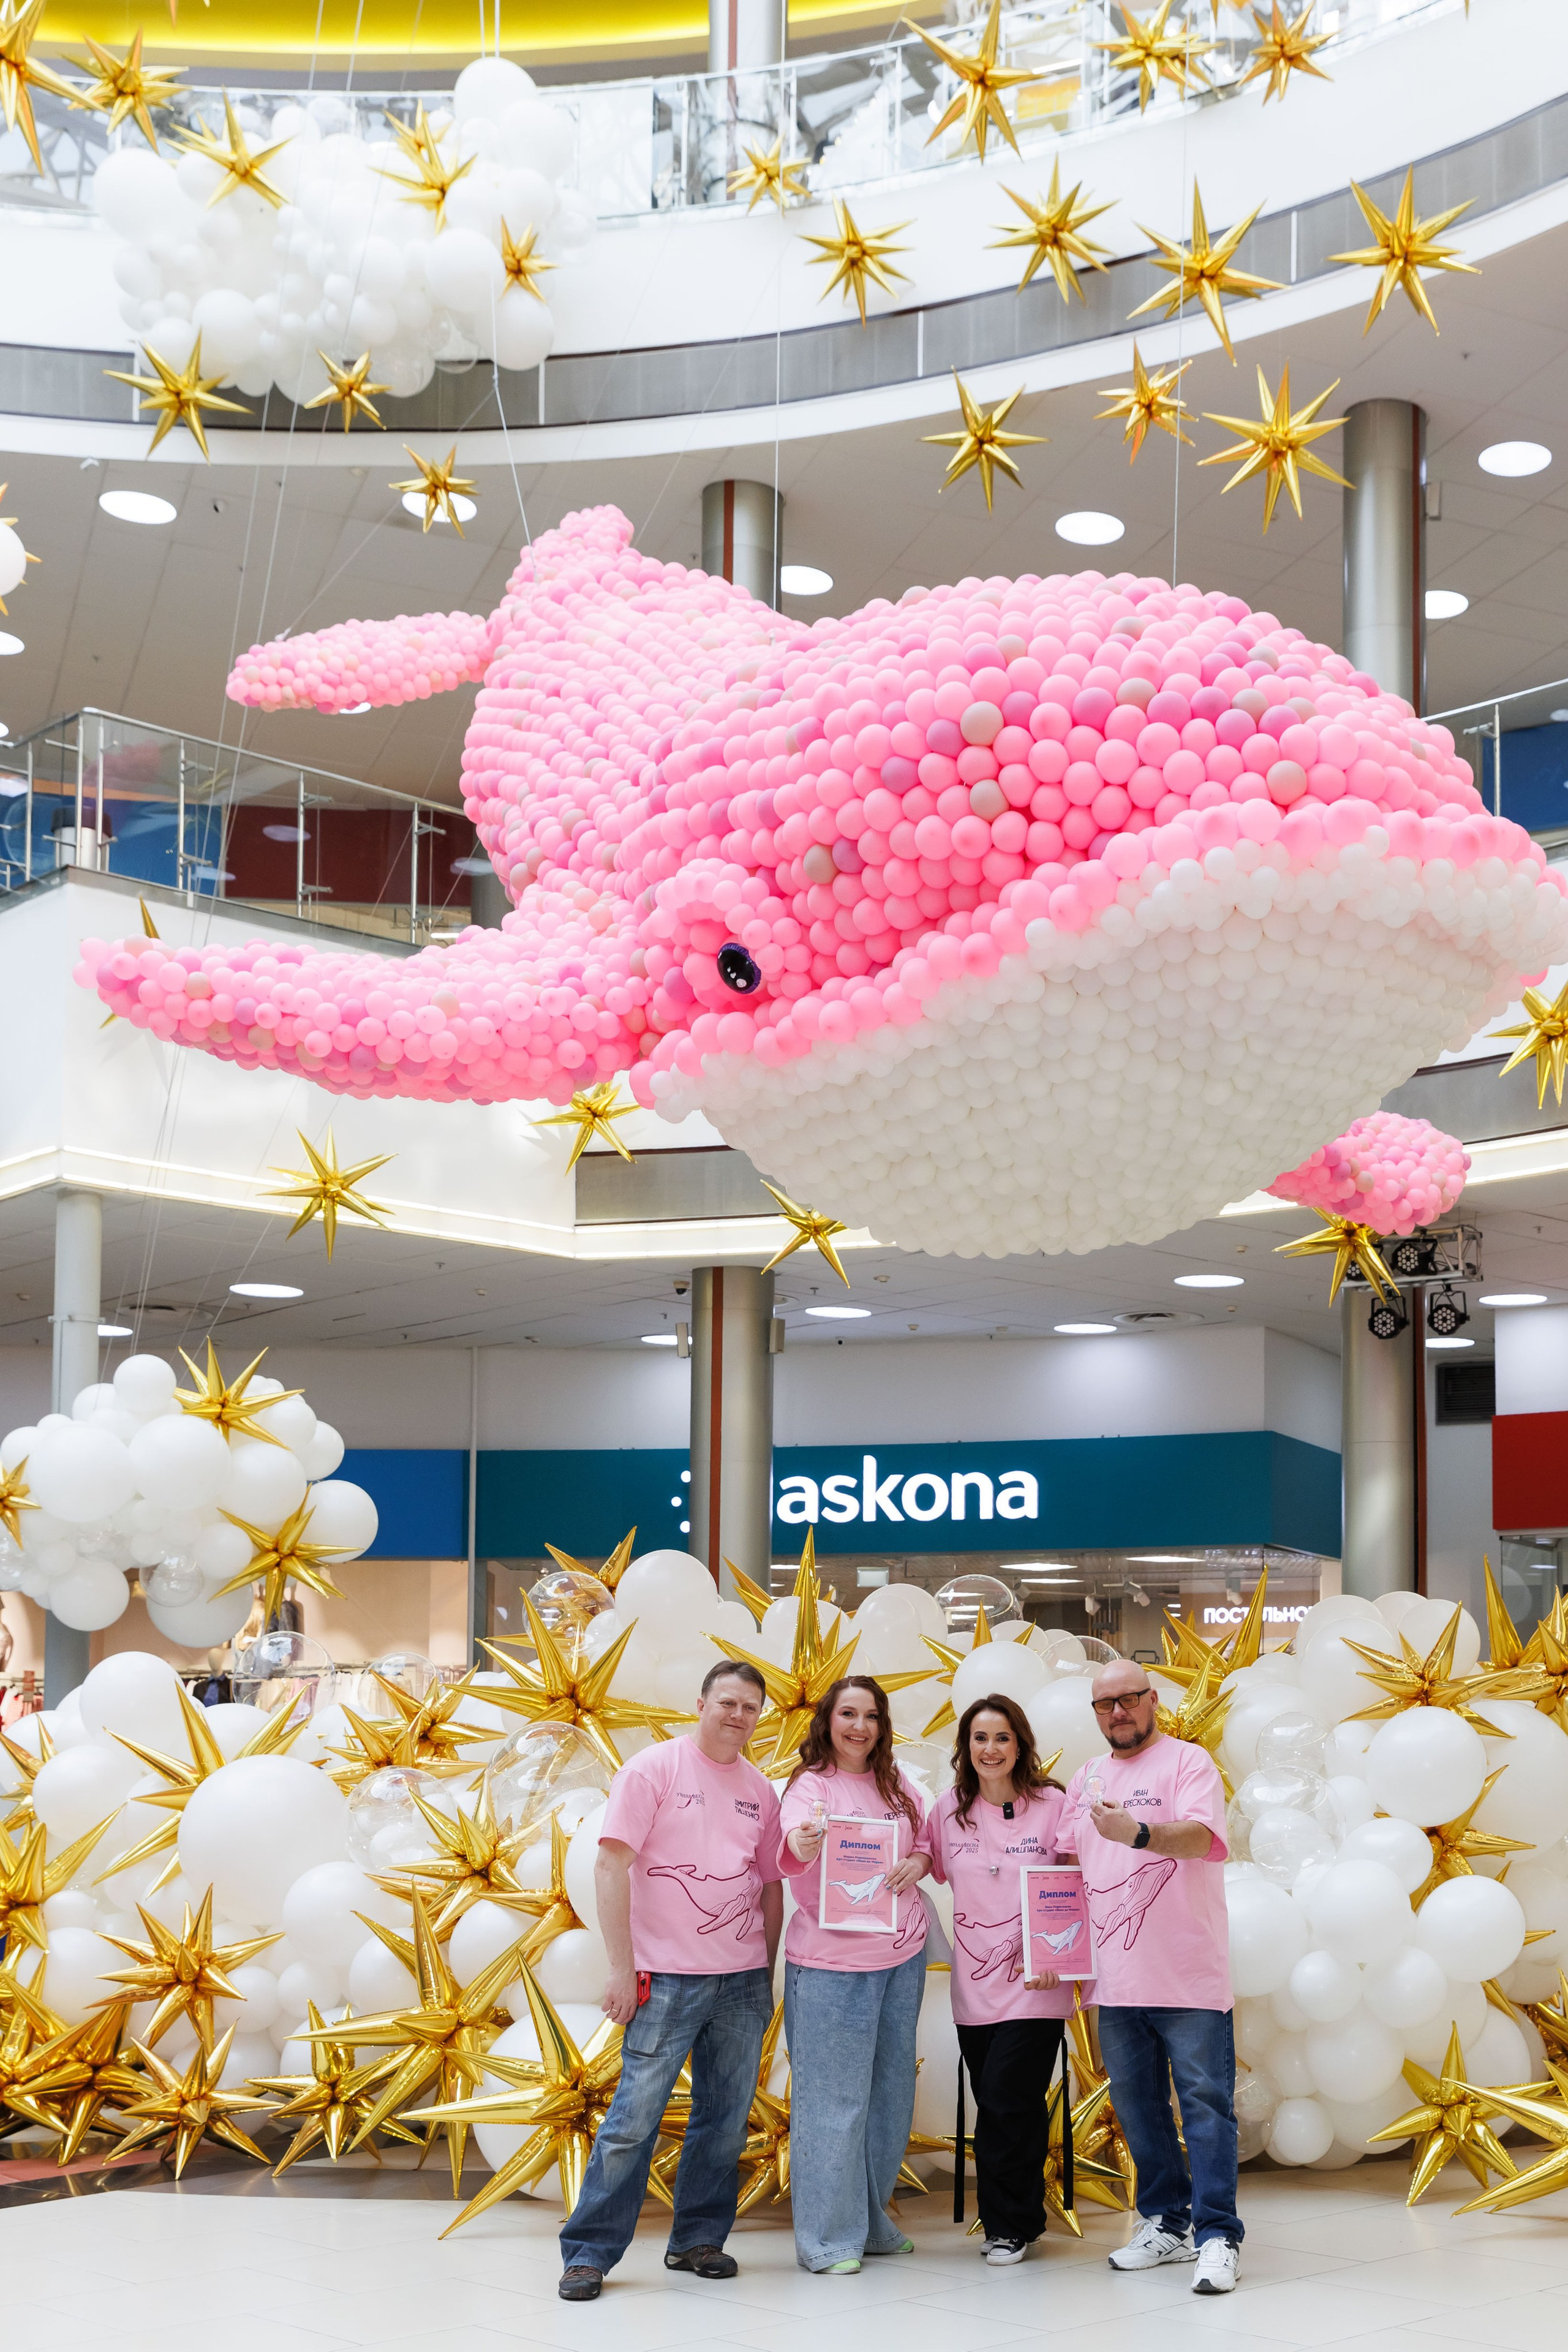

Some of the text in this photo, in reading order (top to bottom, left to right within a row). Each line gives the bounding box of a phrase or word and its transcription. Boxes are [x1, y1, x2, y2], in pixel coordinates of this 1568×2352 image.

[776, 1455, 1039, 1524] askona
[1204, 1605, 1313, 1624] ПОСТЛЬНО
[1123, 1798, 1162, 1808] ЕРЕСКОКОВ
[840, 1840, 881, 1850] Диплом
[1020, 1837, 1038, 1845] ДИНА
[1039, 1890, 1076, 1899] Диплом
